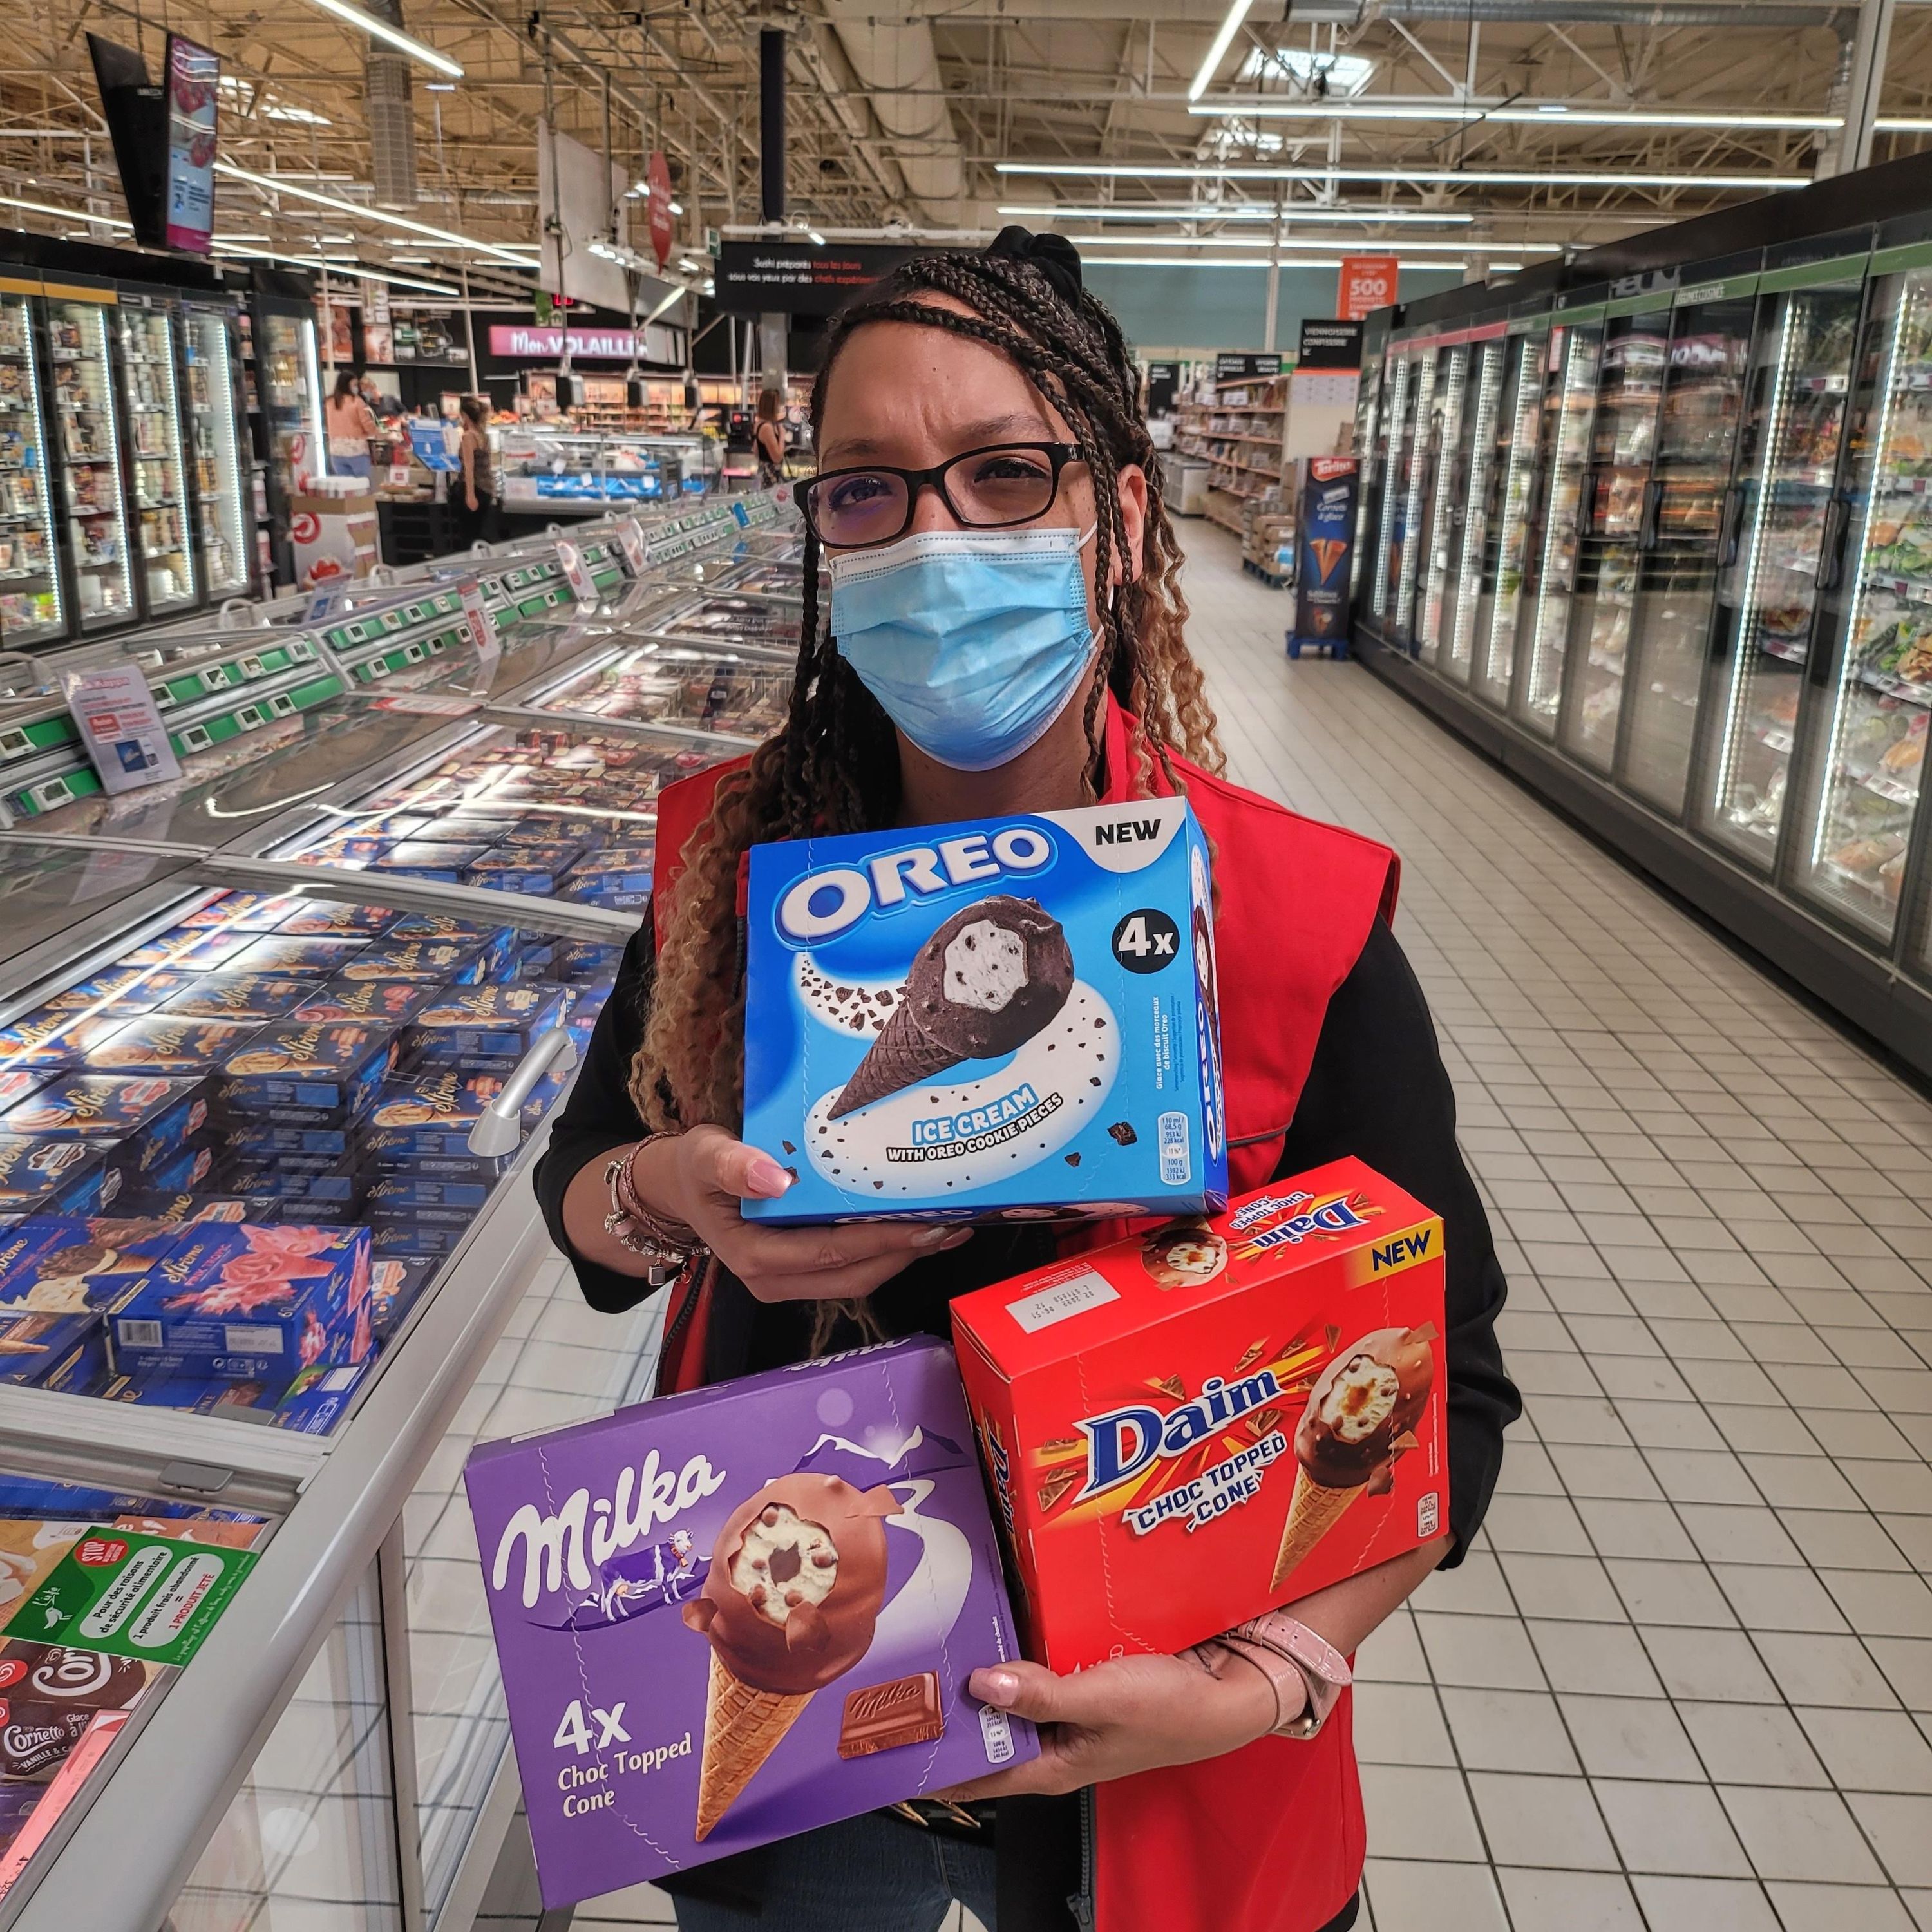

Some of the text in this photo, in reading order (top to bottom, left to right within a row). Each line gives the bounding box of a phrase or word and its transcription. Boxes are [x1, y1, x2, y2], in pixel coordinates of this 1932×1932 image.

[1350, 278, 1388, 296] 500
[1095, 819, 1162, 846] NEW
[781, 829, 1050, 938] OREO
[1117, 917, 1175, 958] 4x
[887, 1094, 1063, 1161] WITH OREO COOKIE PIECES
[914, 1086, 1036, 1143] ICE CREAM
[1231, 1193, 1305, 1228] CHOC TOPPED
[1238, 1198, 1271, 1217] CONE
[1253, 1199, 1364, 1248] Daim
[1371, 1229, 1432, 1271] NEW
[1083, 1371, 1281, 1494] Daim
[1137, 1435, 1286, 1530] CHOC TOPPED
[1197, 1475, 1258, 1522] CONE
[82, 1541, 106, 1562] STOP
[493, 1449, 726, 1609] Milka
[93, 1600, 113, 1618] Pour
[108, 1586, 124, 1600] des
[120, 1560, 144, 1589] raisons
[99, 1622, 113, 1633] de
[109, 1593, 136, 1623] sécurité
[132, 1551, 167, 1593] alimentaire
[140, 1608, 162, 1634] produit
[159, 1593, 173, 1609] frais
[170, 1557, 200, 1593] abandonné
[173, 1591, 202, 1624] PRODUIT
[196, 1573, 215, 1591] JETÉ
[66, 1713, 90, 1723] Glace
[849, 1683, 921, 1720] Milka
[3, 1725, 64, 1757] Cornetto
[70, 1723, 78, 1738] à
[553, 1700, 632, 1755] 4x
[21, 1749, 51, 1768] VANILLE
[558, 1732, 692, 1790] Choc Topped
[563, 1790, 615, 1817] Cone
